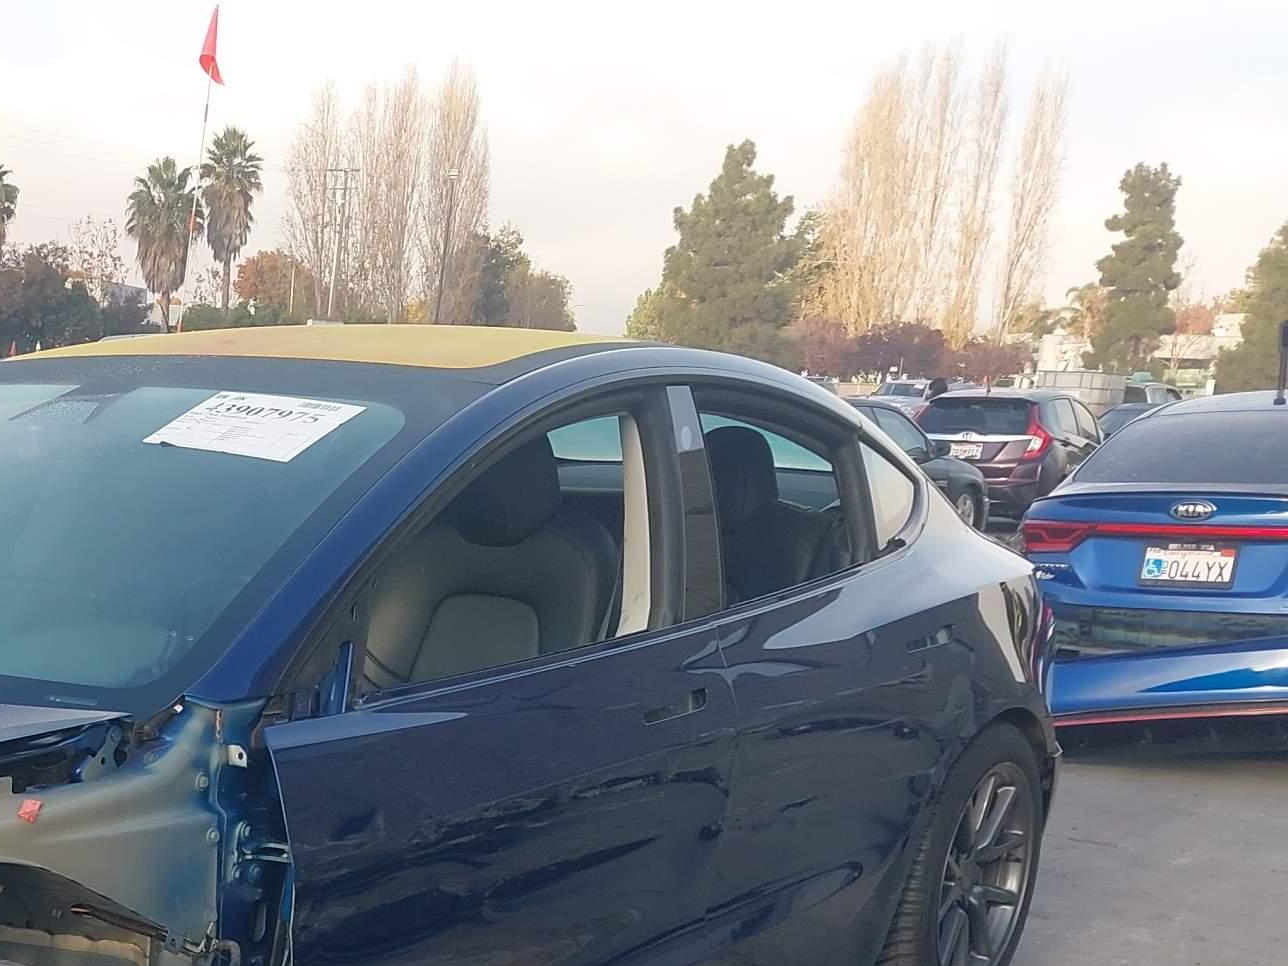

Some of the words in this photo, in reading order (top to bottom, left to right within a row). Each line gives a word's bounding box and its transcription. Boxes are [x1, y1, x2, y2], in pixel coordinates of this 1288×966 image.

[204, 402, 326, 424] 43907975
[1176, 504, 1213, 518] KIA
[1168, 560, 1229, 583] 044YX
